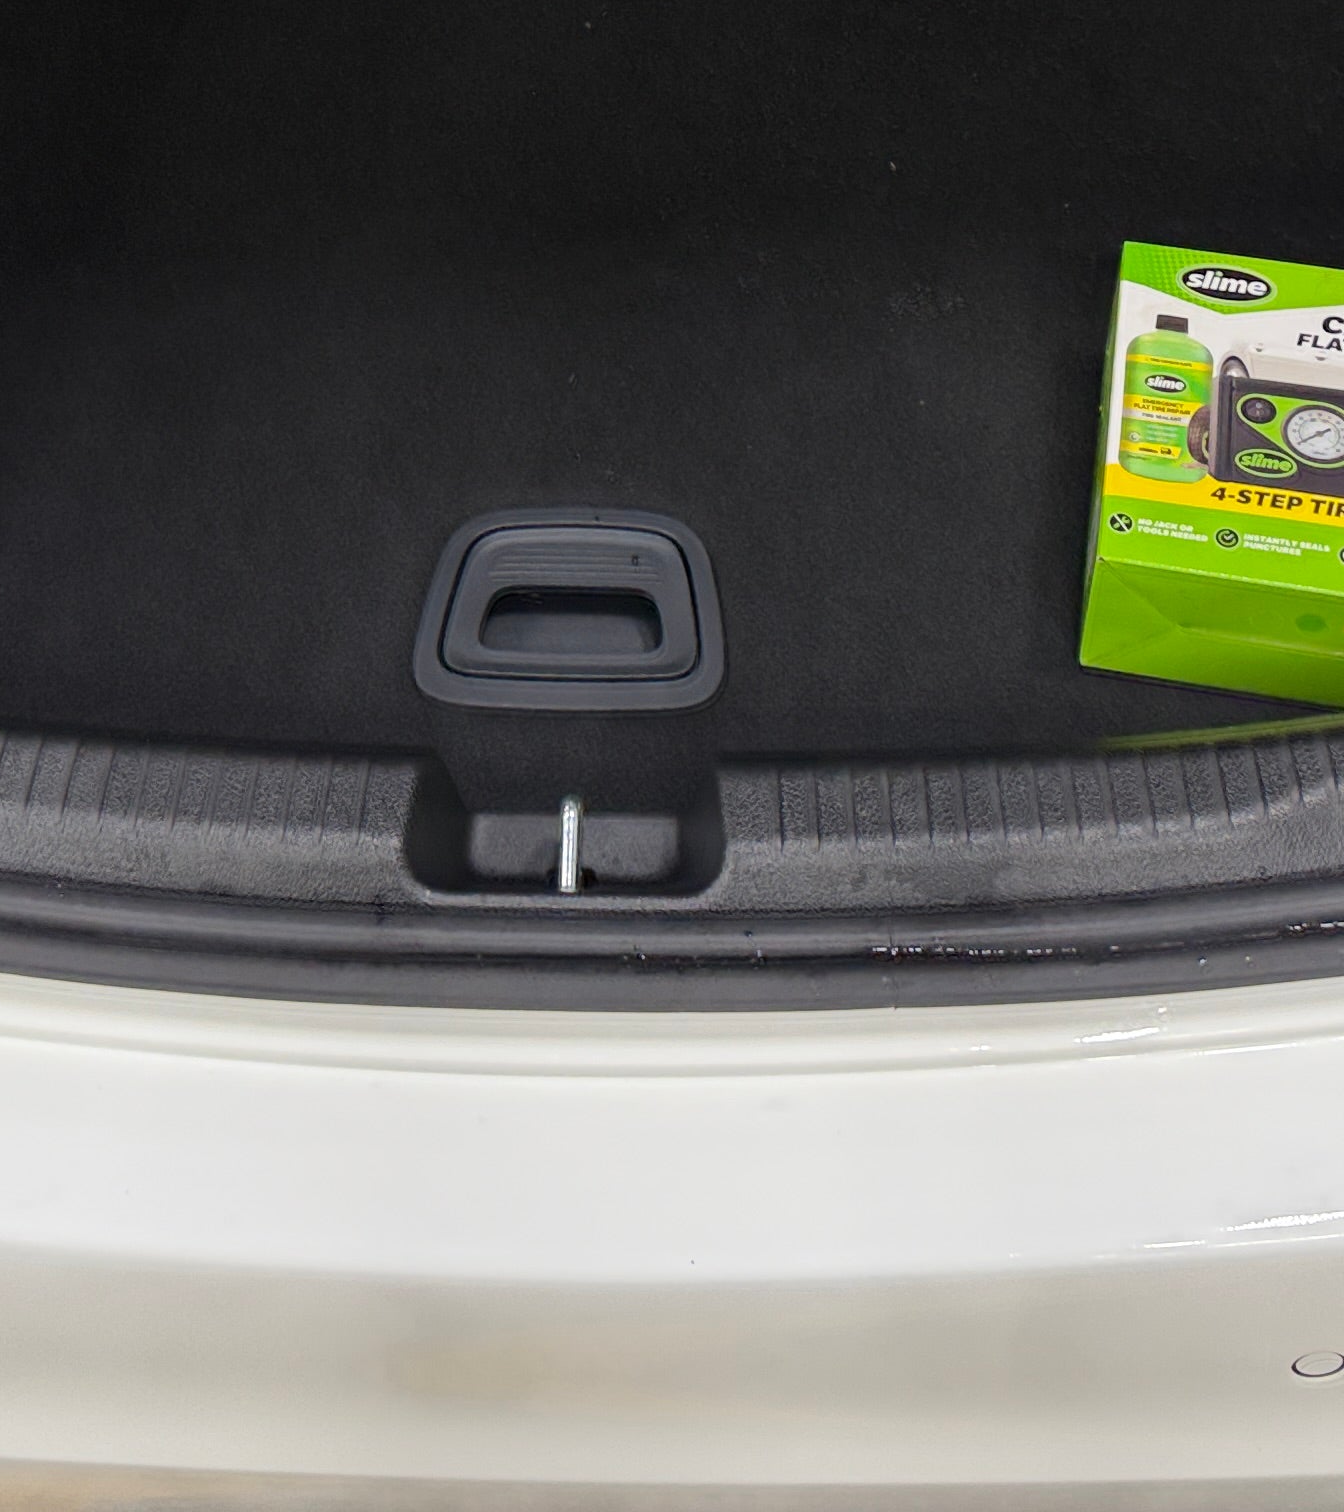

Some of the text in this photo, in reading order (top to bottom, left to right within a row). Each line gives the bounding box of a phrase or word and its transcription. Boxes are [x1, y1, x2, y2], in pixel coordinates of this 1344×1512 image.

[1186, 270, 1268, 297] slime
[1147, 376, 1185, 391] slime
[1240, 453, 1293, 473] slime
[1210, 487, 1304, 511] 4-STEP
[1138, 517, 1194, 532] NO JACK OR
[1137, 526, 1209, 543] TOOLS NEEDED
[1244, 533, 1331, 553] INSTANTLY SEALS
[1243, 542, 1302, 556] PUNCTURES
